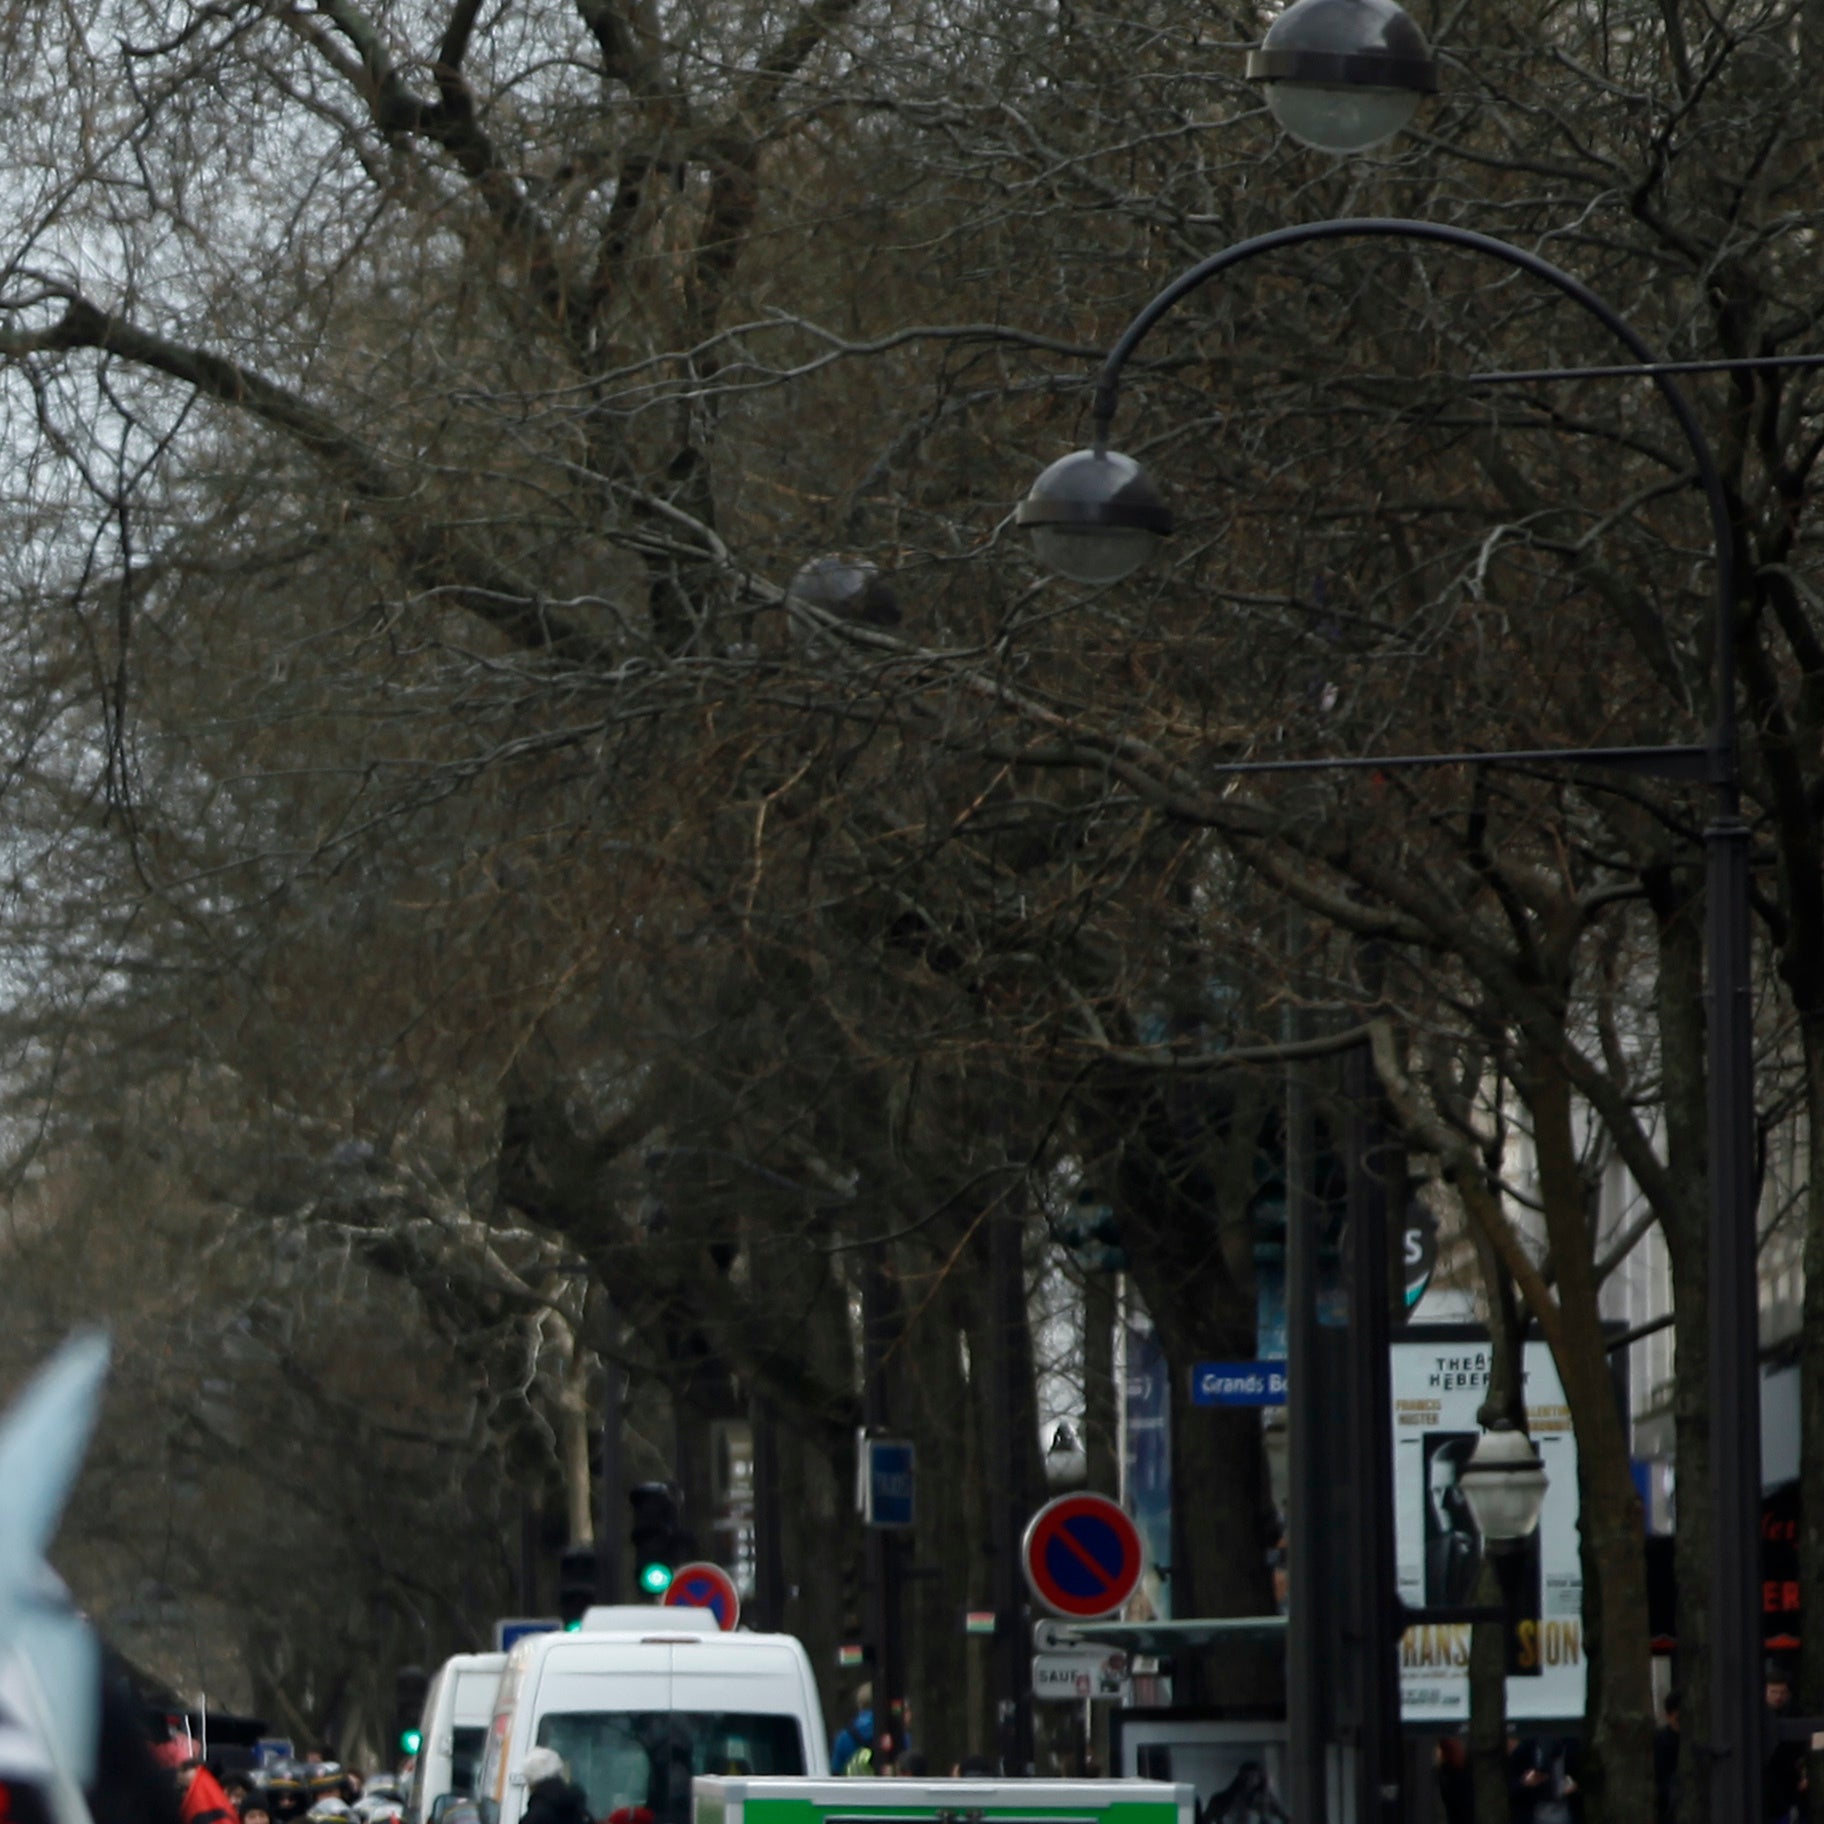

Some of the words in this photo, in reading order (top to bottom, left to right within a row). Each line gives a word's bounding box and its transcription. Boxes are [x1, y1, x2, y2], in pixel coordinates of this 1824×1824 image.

[1435, 1352, 1493, 1371] THEA
[1201, 1373, 1264, 1394] Grands
[1039, 1669, 1078, 1683] SAUF
